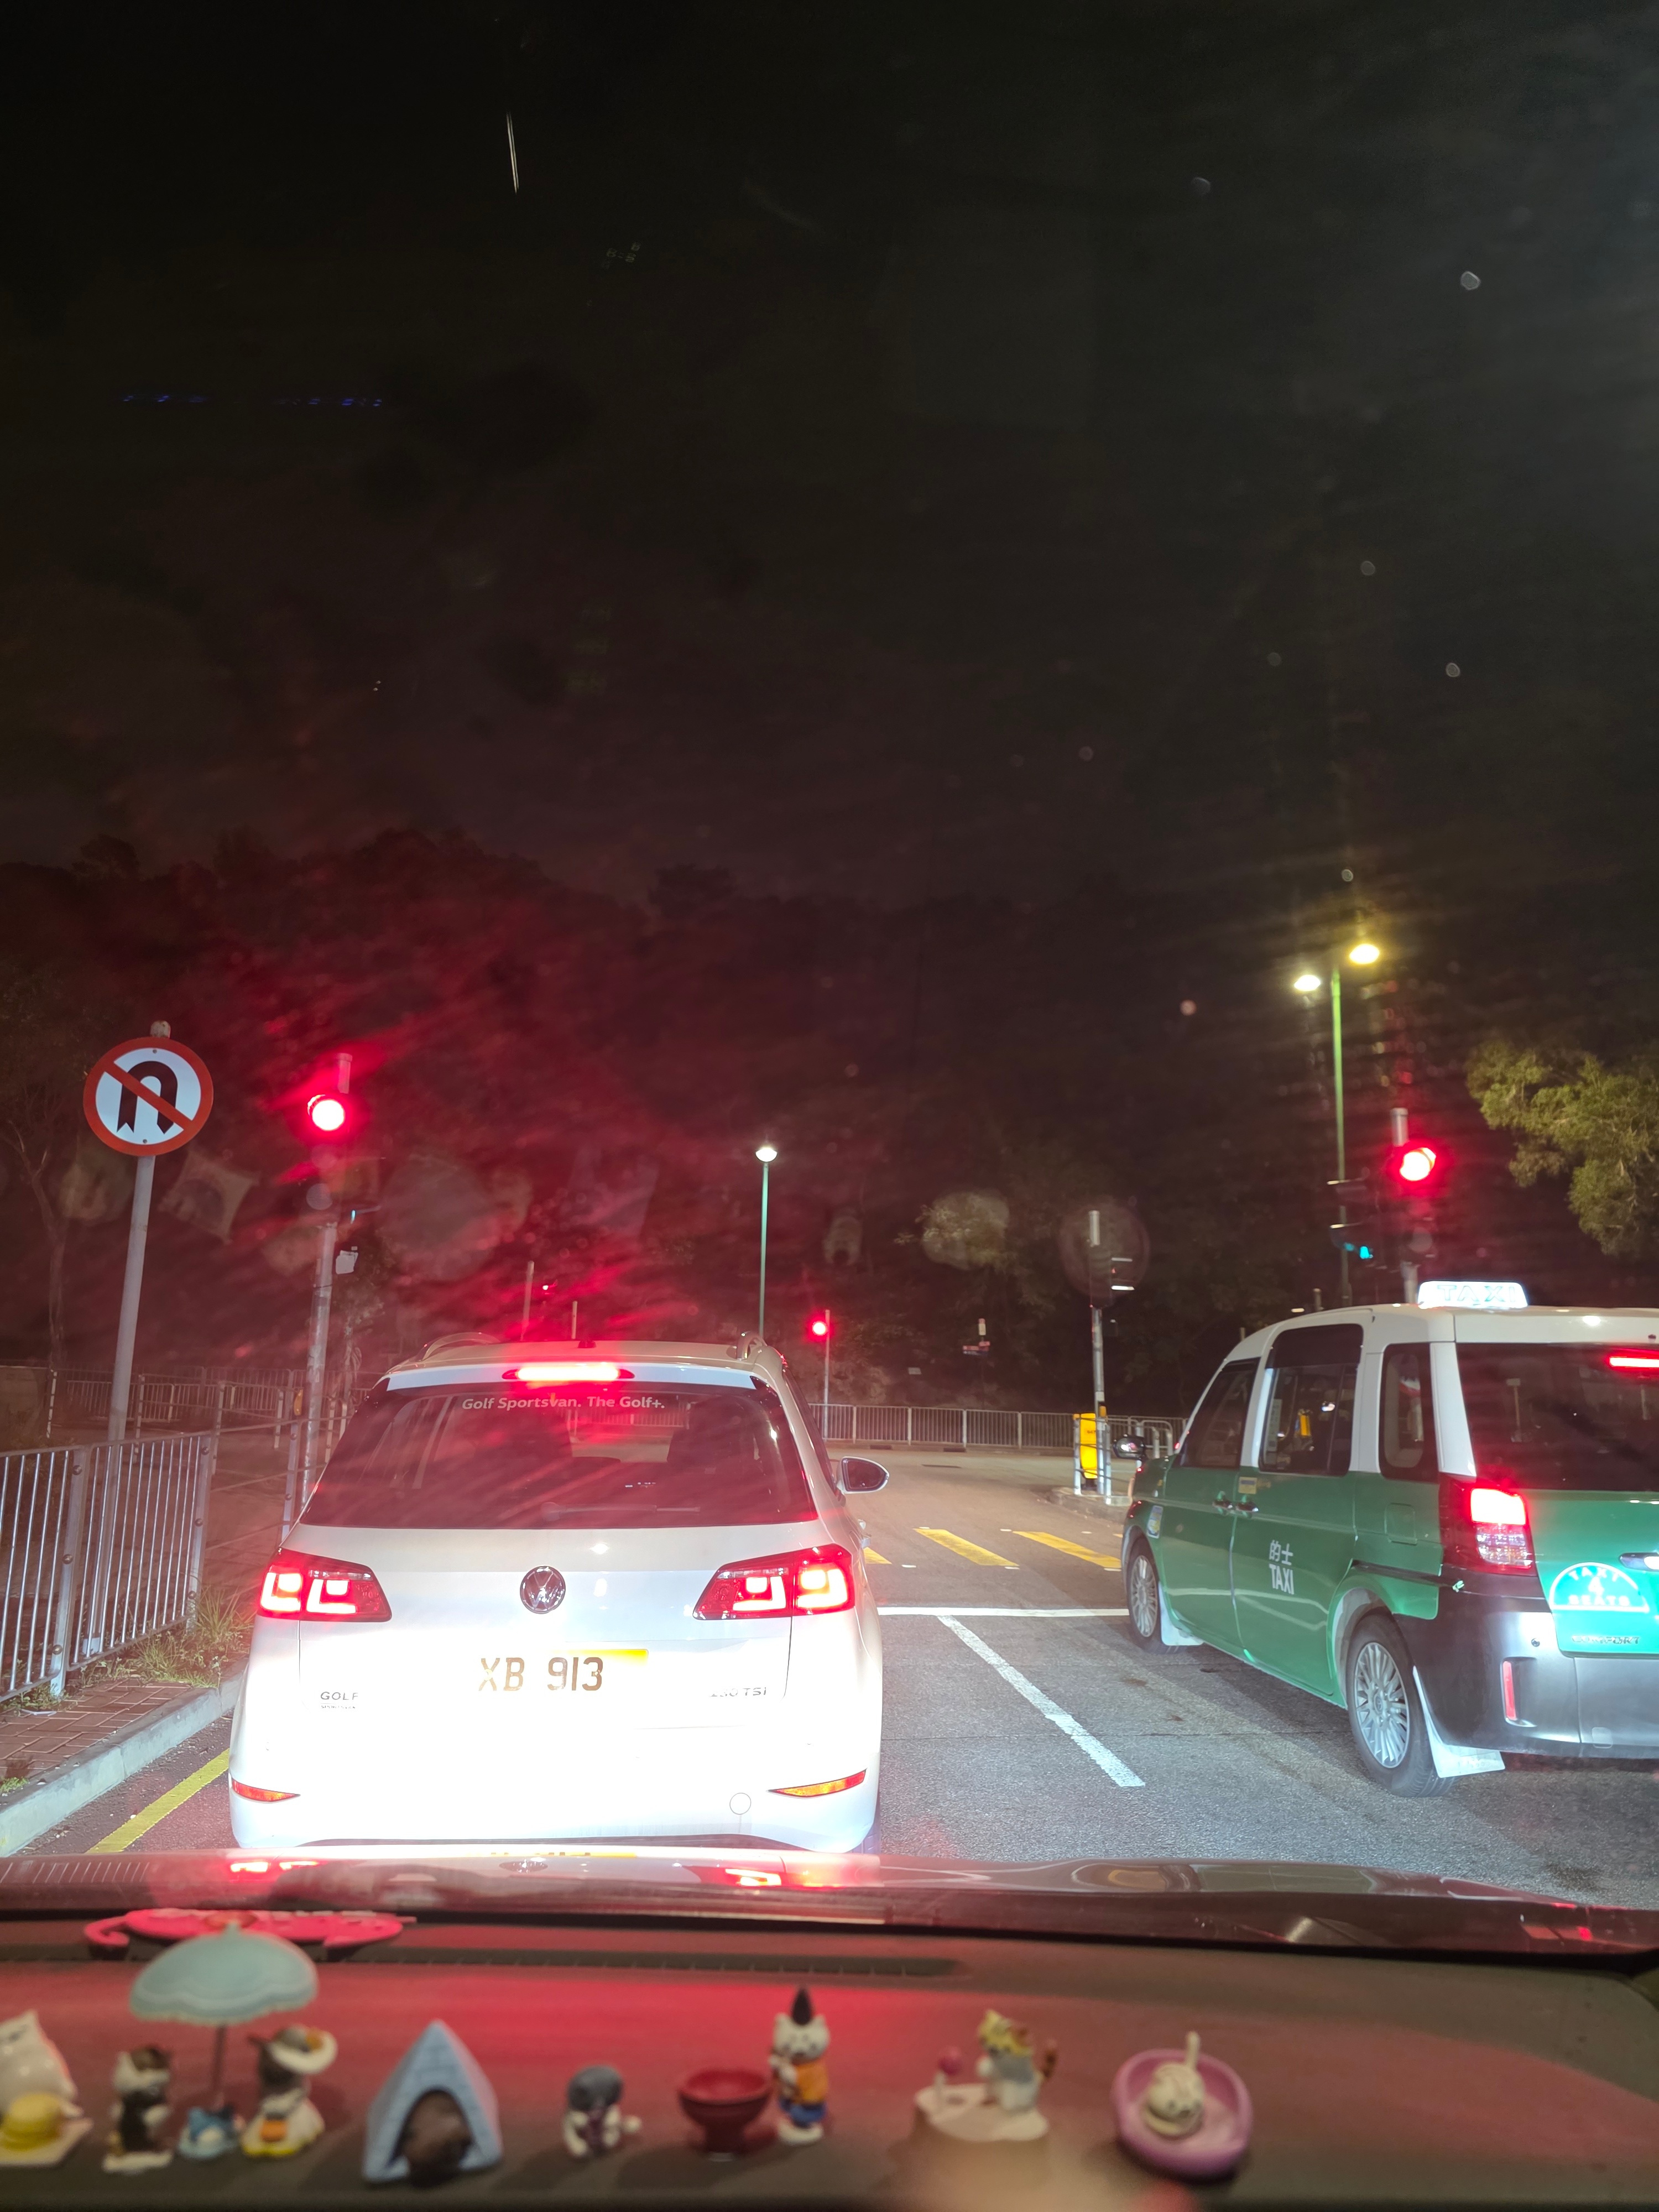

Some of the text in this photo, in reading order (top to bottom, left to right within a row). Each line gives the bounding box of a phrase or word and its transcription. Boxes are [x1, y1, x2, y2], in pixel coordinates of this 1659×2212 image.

[1437, 1285, 1516, 1302] TAXI
[462, 1396, 665, 1411] Golf Sportsvan. The Golf+.
[1269, 1540, 1293, 1565] 的士
[1269, 1563, 1294, 1594] TAXI
[1568, 1566, 1619, 1582] TAXI
[1588, 1576, 1605, 1596] 4
[1568, 1594, 1630, 1605] SEATS
[1572, 1635, 1640, 1644] COMFORT
[479, 1657, 603, 1691] XB 913
[321, 1691, 358, 1700] GOLF
[743, 1687, 766, 1696] TSI
